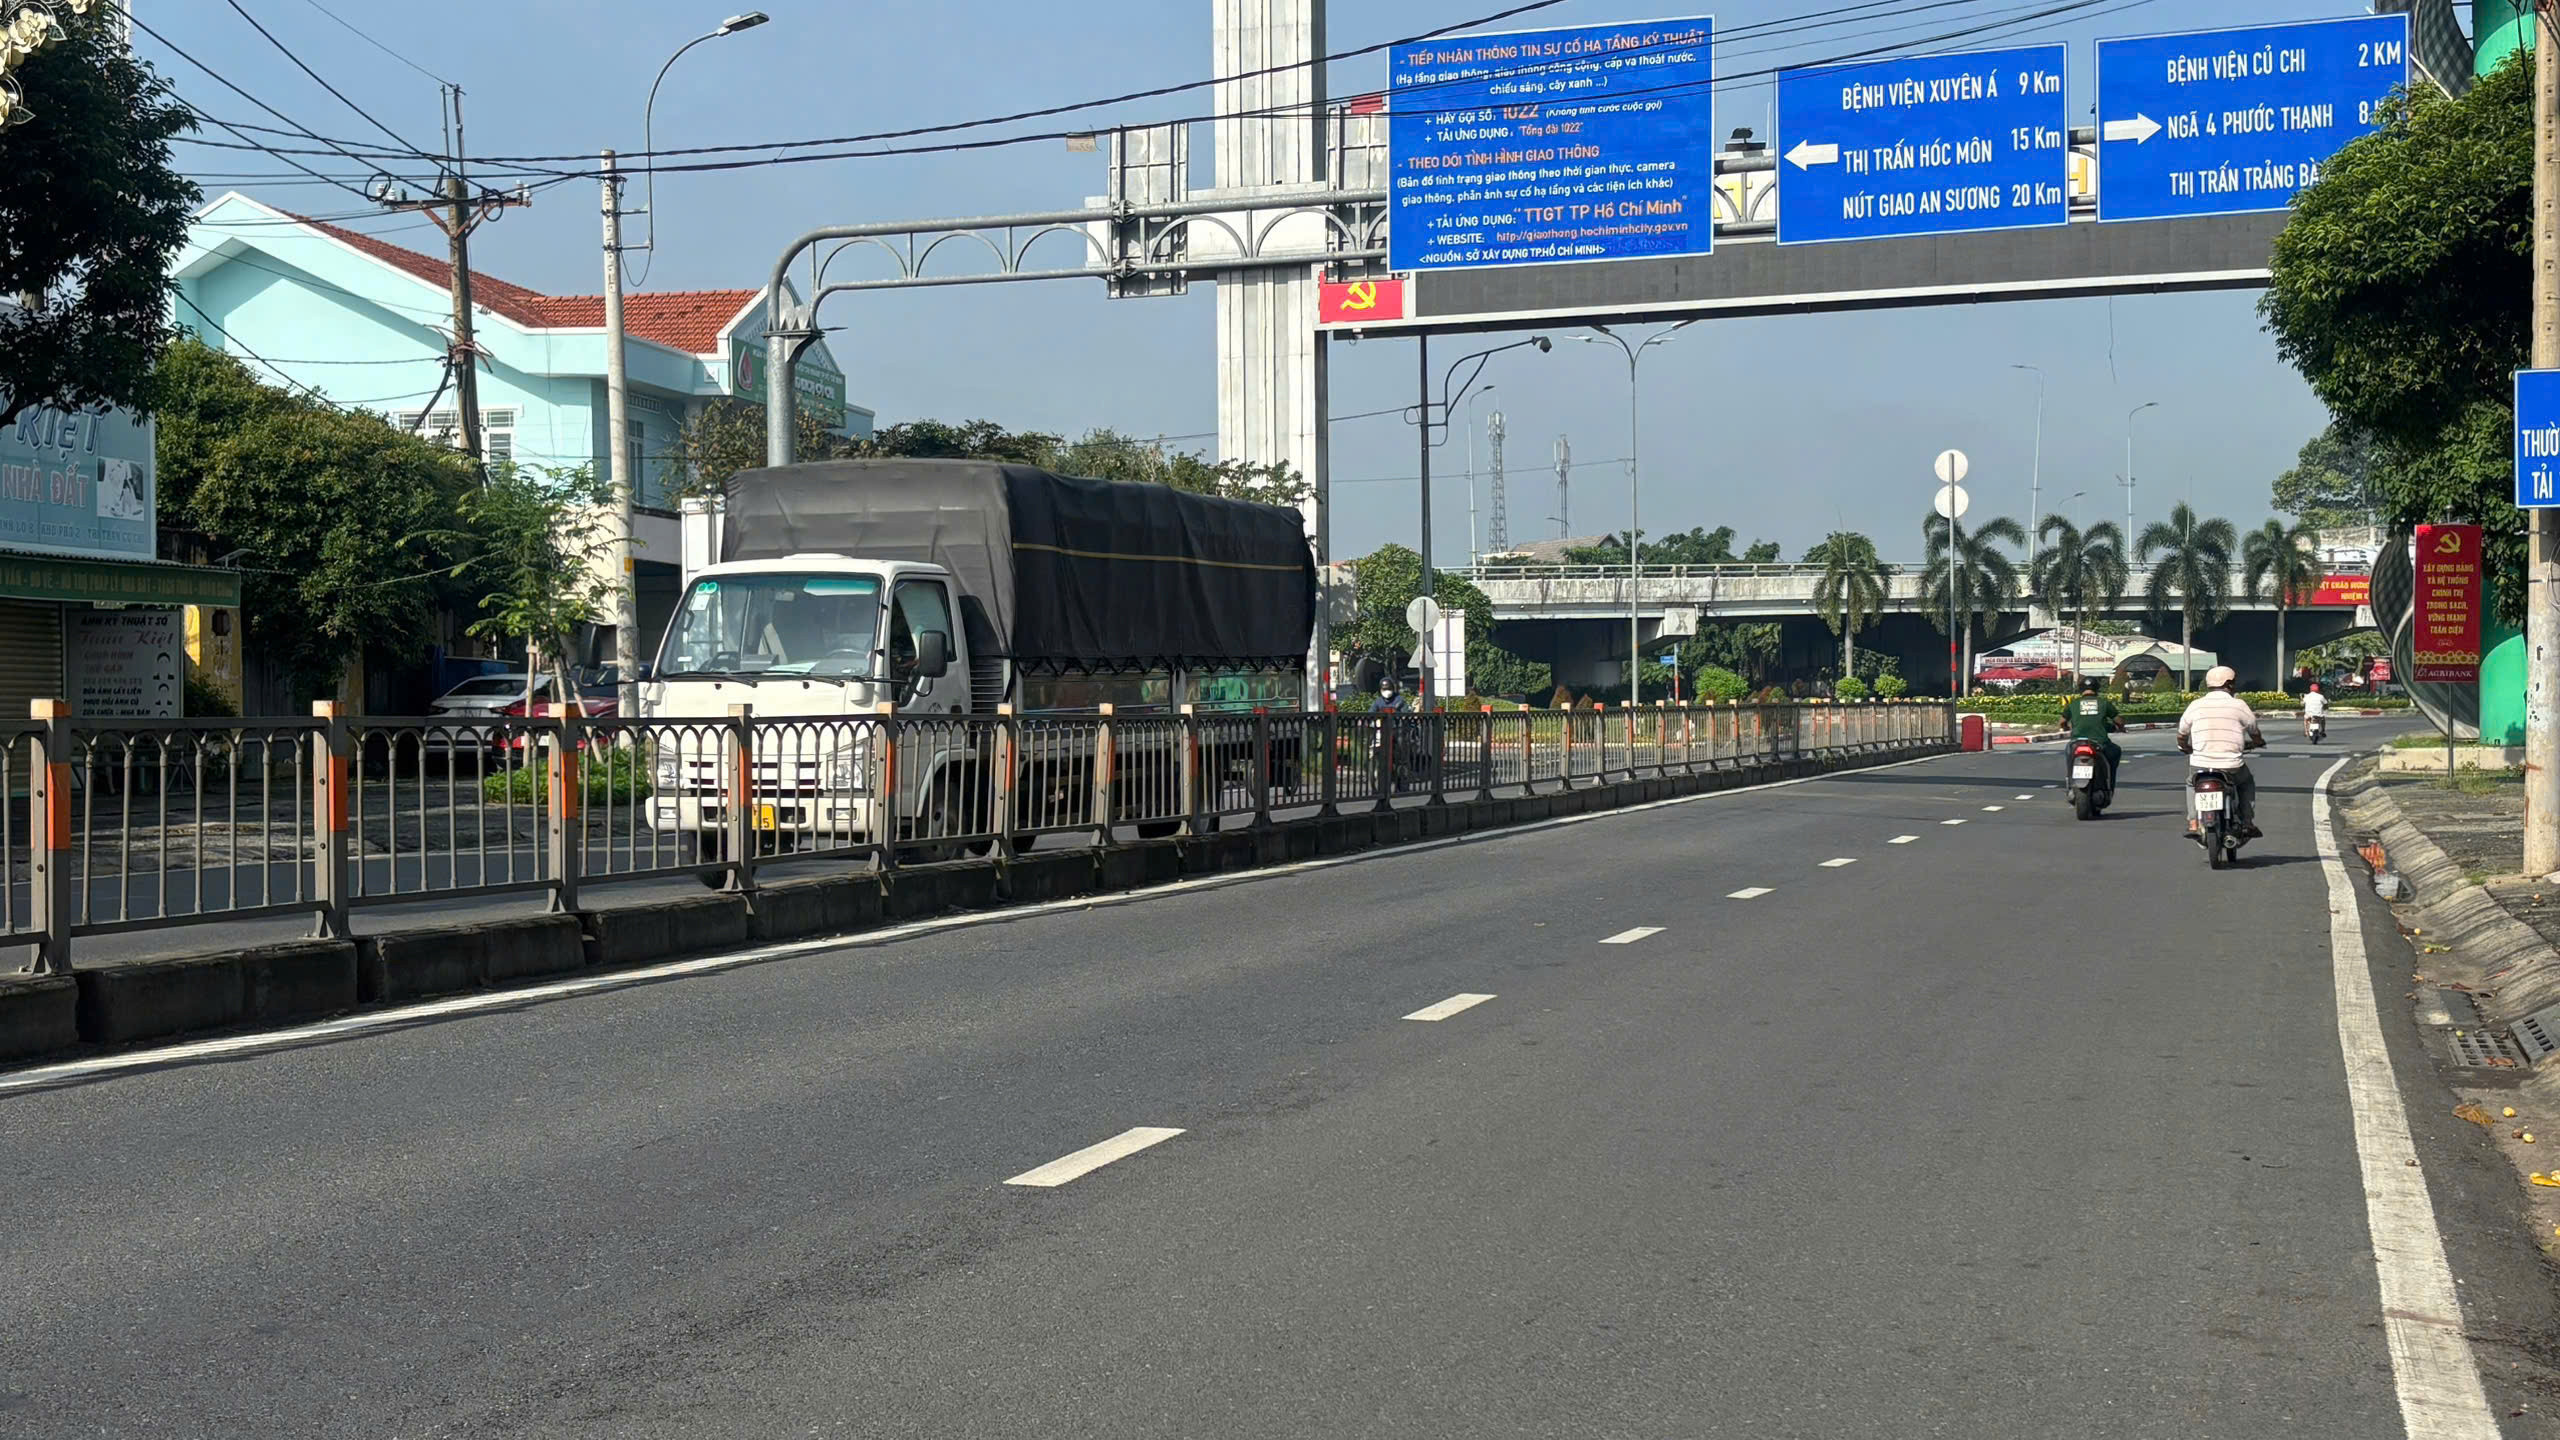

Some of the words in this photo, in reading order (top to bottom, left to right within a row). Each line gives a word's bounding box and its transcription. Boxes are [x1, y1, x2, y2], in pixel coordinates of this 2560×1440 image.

[1408, 50, 1434, 66] TIẾP
[1475, 45, 1517, 60] THÔNG
[1520, 45, 1540, 57] TIN
[1544, 42, 1561, 58] SỰ
[1565, 37, 1581, 54] CỐ
[1584, 39, 1602, 55] HẠ
[1605, 34, 1639, 51] TẦNG
[1643, 32, 1659, 47] KỸ
[2167, 55, 2208, 86] BỆNH
[2212, 50, 2248, 82] VIỆN
[2252, 44, 2274, 76] CỦ
[2279, 48, 2306, 73] CHI
[2358, 43, 2369, 67] 2
[2374, 41, 2401, 65] KM
[1490, 81, 1517, 95] chiếu
[1549, 80, 1566, 92] cây
[1568, 77, 1593, 89] xanh
[1842, 82, 1884, 113] BỆNH
[1888, 77, 1925, 109] VIỆN
[1929, 72, 1982, 103] XUYÊN
[1986, 68, 1998, 98] Á
[2019, 72, 2029, 95] 9
[2033, 70, 2060, 94] Km
[1436, 128, 1453, 142] TẢI
[1545, 123, 1559, 134] đài
[2168, 110, 2199, 140] NGÃ
[2205, 112, 2217, 136] 4
[2223, 102, 2275, 136] PHƯỚC
[2280, 104, 2333, 134] THẠNH
[2359, 101, 2369, 124] 8
[1408, 157, 1439, 169] THEO
[1442, 152, 1462, 168] DÕI
[1464, 149, 1492, 166] TÌNH
[1495, 148, 1523, 164] HÌNH
[1525, 148, 1554, 161] GIAO
[1557, 144, 1600, 160] THÔNG
[1844, 150, 1869, 176] THỊ
[1873, 138, 1914, 171] TRẤN
[1920, 136, 1951, 168] HÓC
[1956, 136, 1992, 165] MÔN
[2011, 128, 2029, 151] 15
[2034, 126, 2061, 149] Km
[1397, 176, 1419, 189] (Bản
[1421, 175, 1434, 186] đồ
[1436, 174, 1454, 185] tình
[1457, 173, 1483, 187] trạng
[1485, 172, 1506, 182] giao
[1508, 169, 1536, 182] thông
[1539, 168, 1560, 179] theo
[1563, 165, 1582, 176] thời
[1584, 165, 1606, 178] gian
[1637, 161, 1675, 172] camera
[1402, 196, 1422, 207] giao
[1457, 190, 1481, 203] phản
[1484, 189, 1503, 200] ánh
[1505, 189, 1518, 200] sự
[1520, 185, 1533, 197] cố
[1534, 186, 1546, 199] hạ
[1549, 183, 1571, 197] tầng
[1573, 184, 1585, 194] và
[1587, 181, 1604, 193] các
[1606, 180, 1625, 194] tiện
[1628, 179, 1643, 190] ích
[1645, 177, 1673, 189] khác)
[2169, 171, 2194, 199] THỊ
[2198, 160, 2239, 194] TRẤN
[2243, 159, 2295, 189] TRẢNG
[2299, 157, 2320, 187] BÀ
[1436, 214, 1453, 228] TẢI
[1456, 213, 1479, 227] ỨNG
[1482, 214, 1516, 228] DỤNG:
[1569, 205, 1590, 220] TP
[1594, 202, 1615, 218] Hồ
[1619, 200, 1644, 217] Chí
[1843, 190, 1874, 220] NÚT
[1879, 192, 1915, 217] GIAO
[1919, 189, 1941, 214] AN
[1945, 185, 2001, 211] SƯƠNG
[2012, 184, 2030, 208] 20
[2034, 182, 2061, 206] Km
[1437, 233, 1485, 245] WEBSITE:
[1465, 249, 1479, 261] SỞ
[1481, 248, 1500, 260] XÂY
[1502, 248, 1528, 260] DỰNG
[1557, 243, 1573, 256] CHÍ
[15, 405, 104, 462] KIỆT
[2, 459, 43, 503] NHÀ
[50, 461, 89, 509] ĐẤT
[2531, 463, 2552, 499] TẢI
[2428, 670, 2472, 678] AGRIBANK
